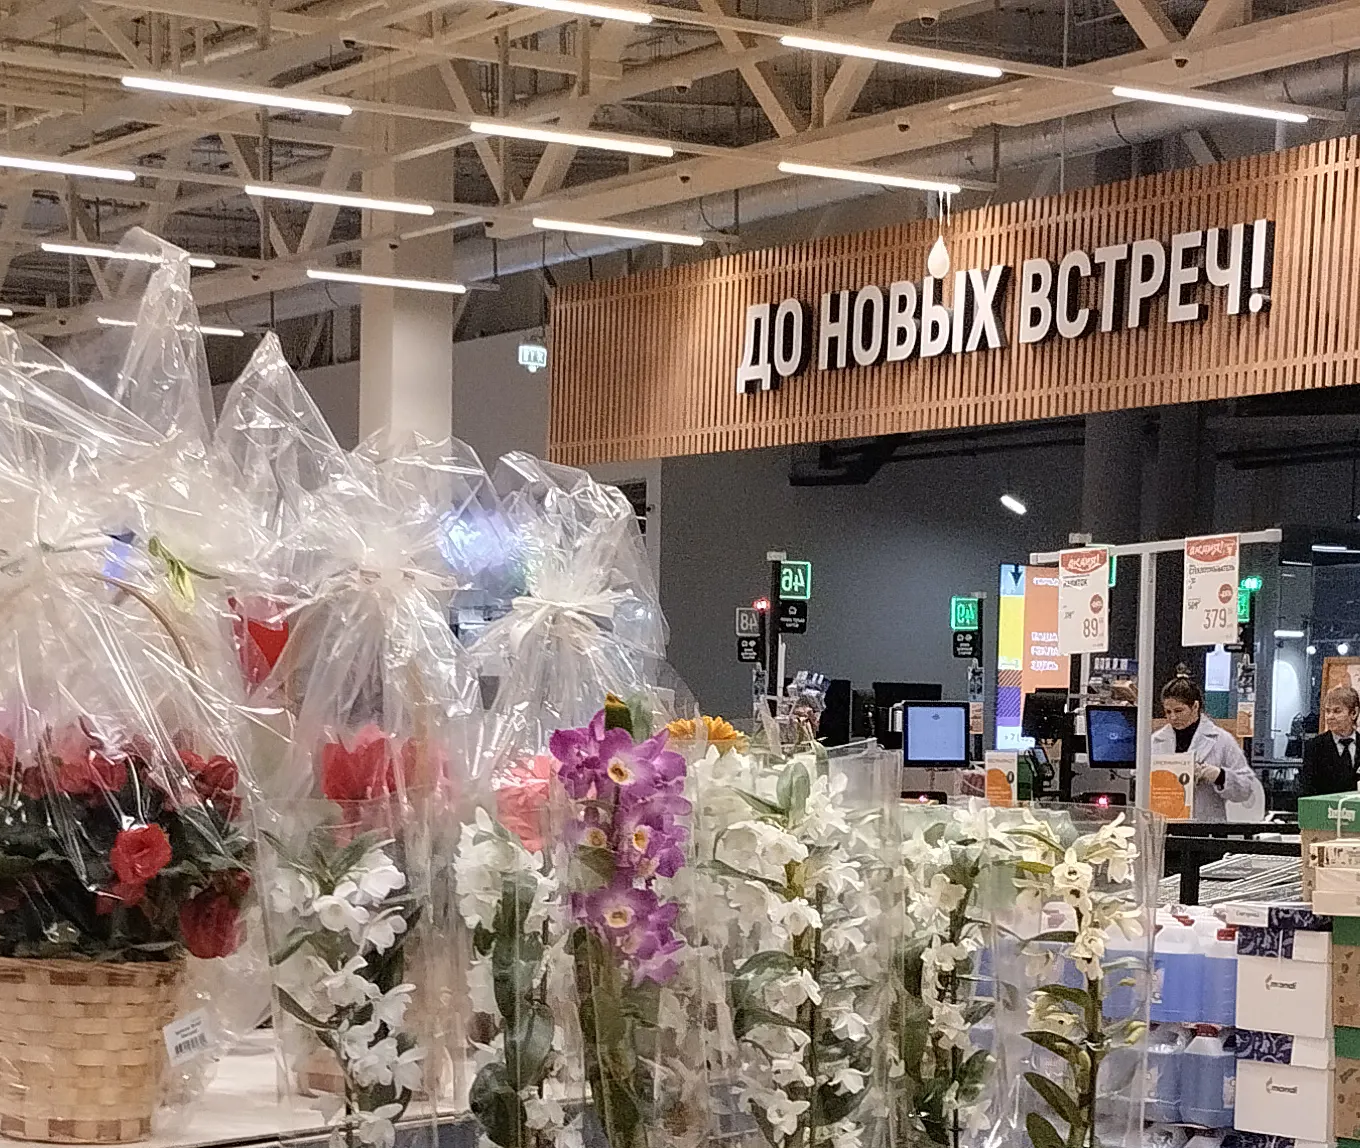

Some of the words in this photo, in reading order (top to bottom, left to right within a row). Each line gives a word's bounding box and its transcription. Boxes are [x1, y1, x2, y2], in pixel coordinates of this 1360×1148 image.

[736, 298, 808, 395] ДО
[817, 263, 1011, 371] НОВЫХ
[1018, 218, 1276, 345] ВСТРЕЧ!
[1082, 617, 1100, 639] 89
[1202, 607, 1228, 631] 379
[1271, 1085, 1298, 1095] mondi
